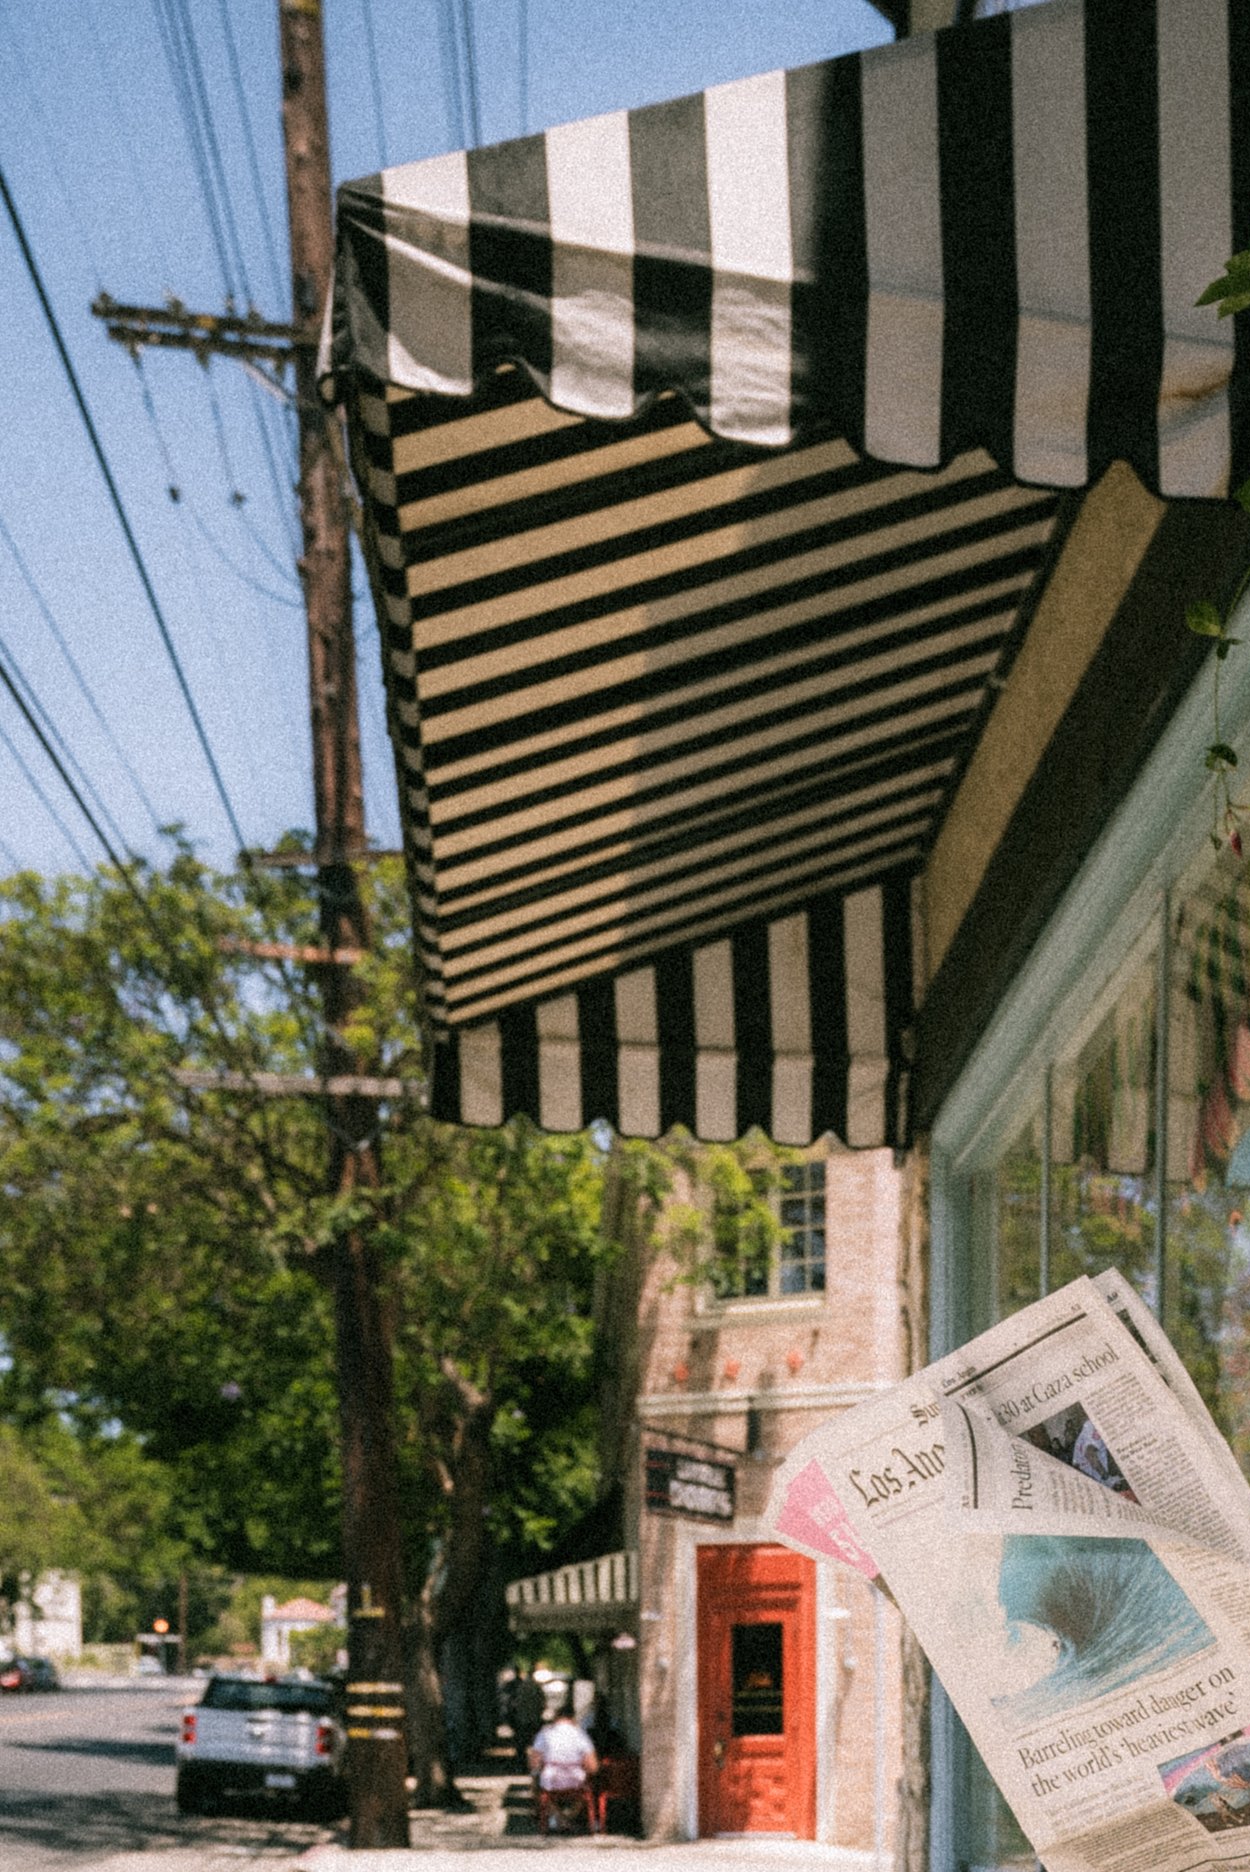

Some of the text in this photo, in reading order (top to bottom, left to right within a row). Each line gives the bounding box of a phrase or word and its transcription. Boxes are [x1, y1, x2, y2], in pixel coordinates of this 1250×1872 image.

[1019, 1395, 1035, 1415] at
[1032, 1373, 1074, 1404] Gaza
[1073, 1343, 1120, 1382] school
[849, 1467, 902, 1508] Los
[1017, 1666, 1236, 1770] Barreling toward danger on
[1031, 1773, 1061, 1797] the
[1063, 1746, 1122, 1783] world's
